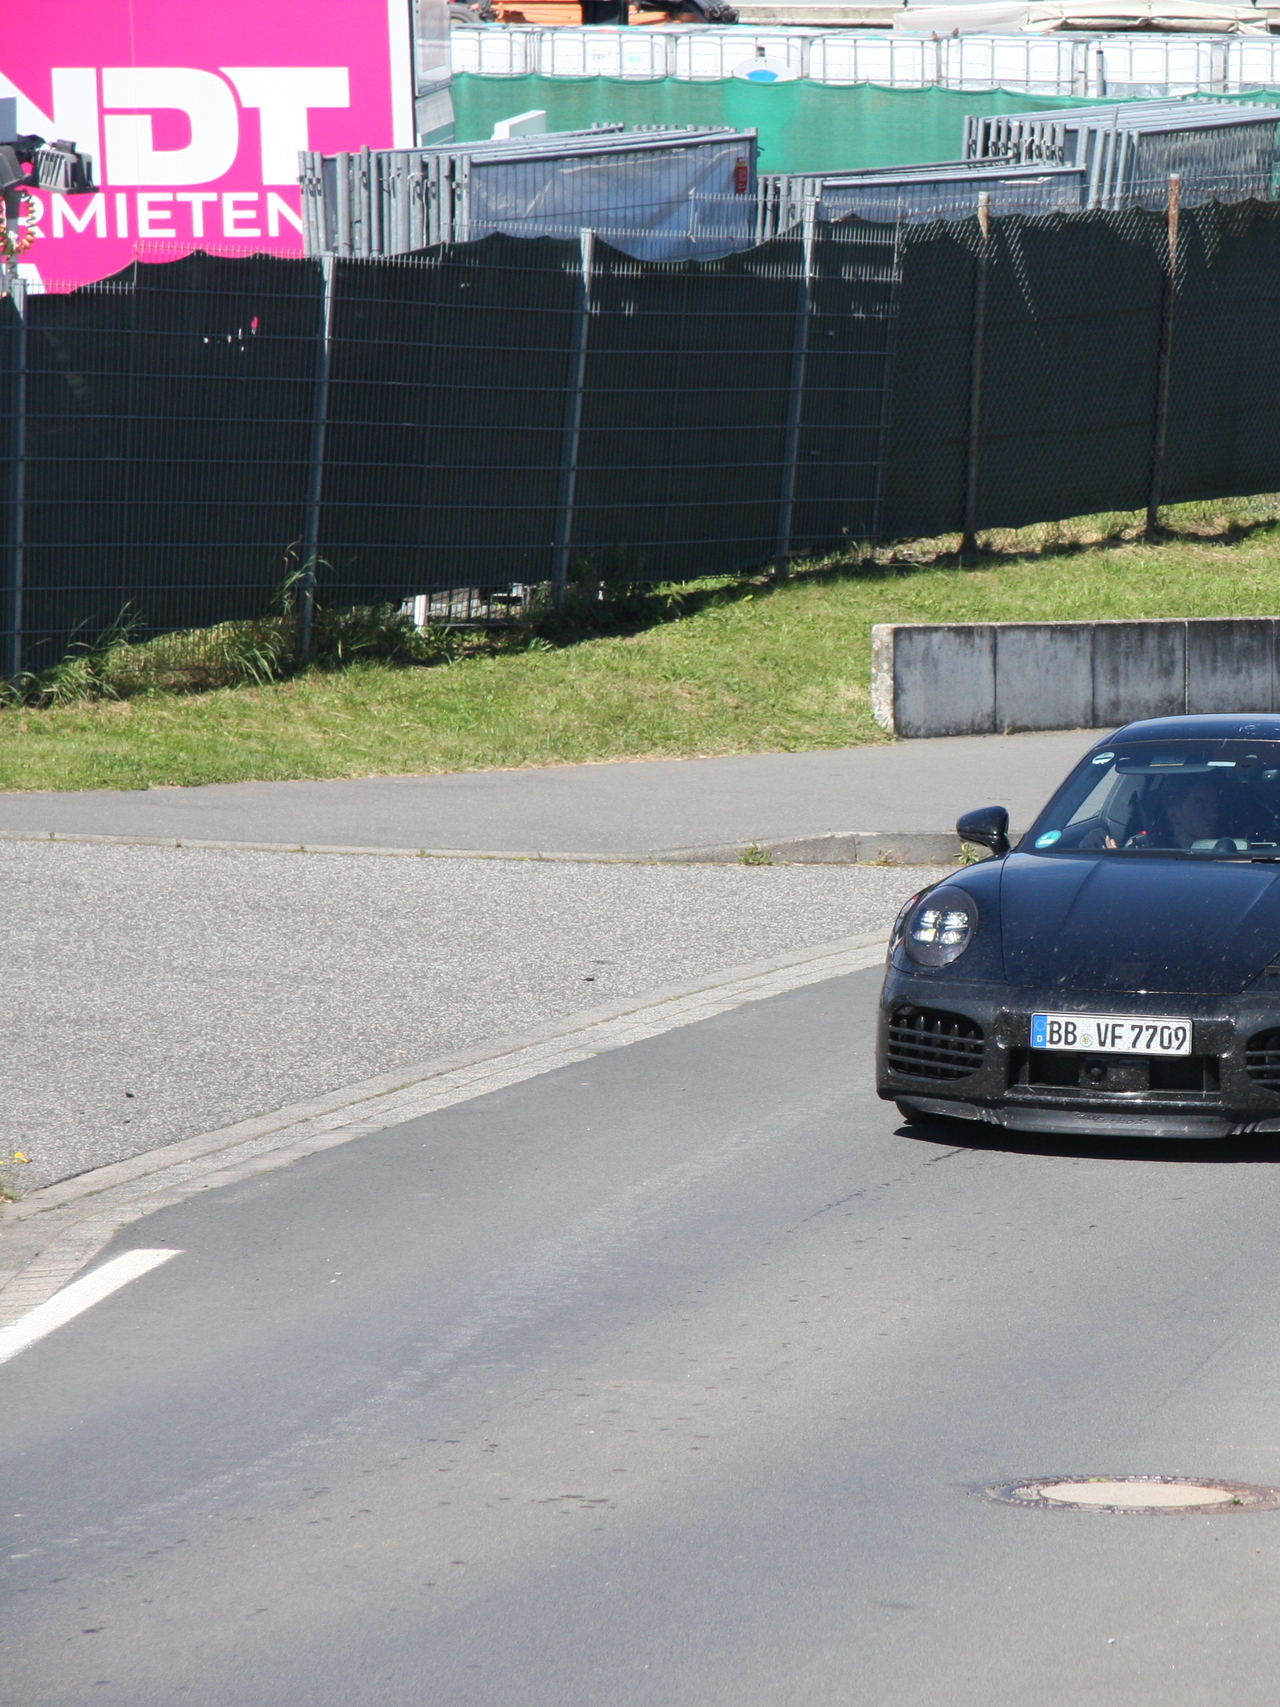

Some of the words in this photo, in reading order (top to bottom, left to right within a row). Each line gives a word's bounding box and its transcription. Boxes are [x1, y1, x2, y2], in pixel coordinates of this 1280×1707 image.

[1049, 1020, 1077, 1046] BB
[1096, 1022, 1124, 1047] VF
[1130, 1024, 1187, 1051] 7709
